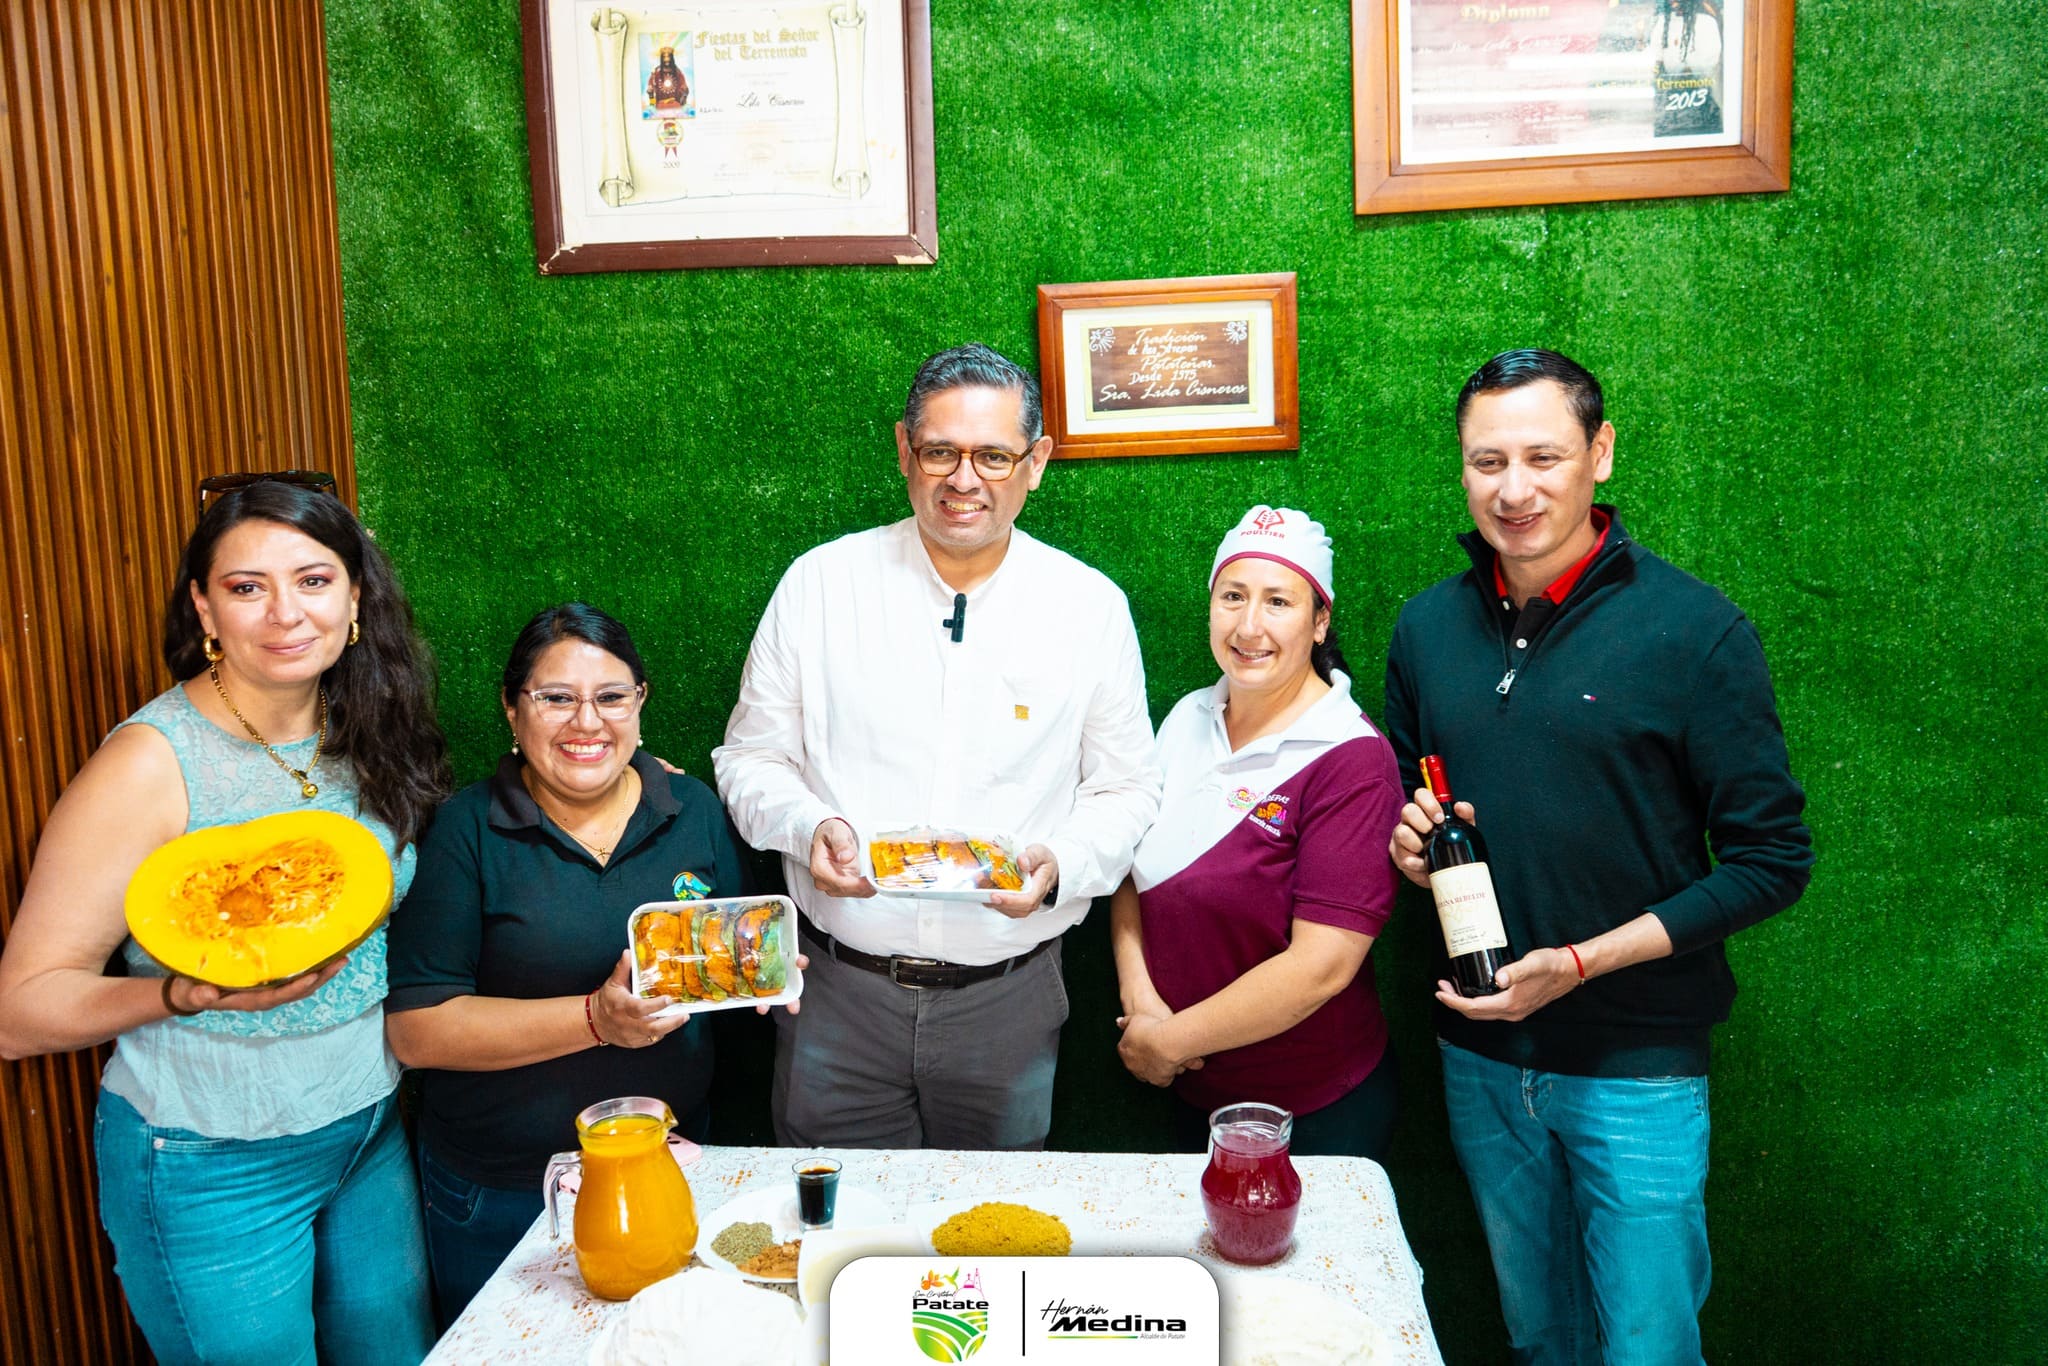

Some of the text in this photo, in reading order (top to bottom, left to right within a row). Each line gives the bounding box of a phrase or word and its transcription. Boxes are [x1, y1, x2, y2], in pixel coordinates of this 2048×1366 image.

[694, 31, 747, 48] Fiestas
[752, 29, 771, 43] del
[714, 45, 808, 61] del Terremoto
[1655, 77, 1717, 90] Terremoto
[1665, 88, 1708, 111] 2013
[1135, 327, 1207, 345] Tradición
[1127, 371, 1162, 386] Desde
[1099, 378, 1248, 402] Sra. Lida Cisneros
